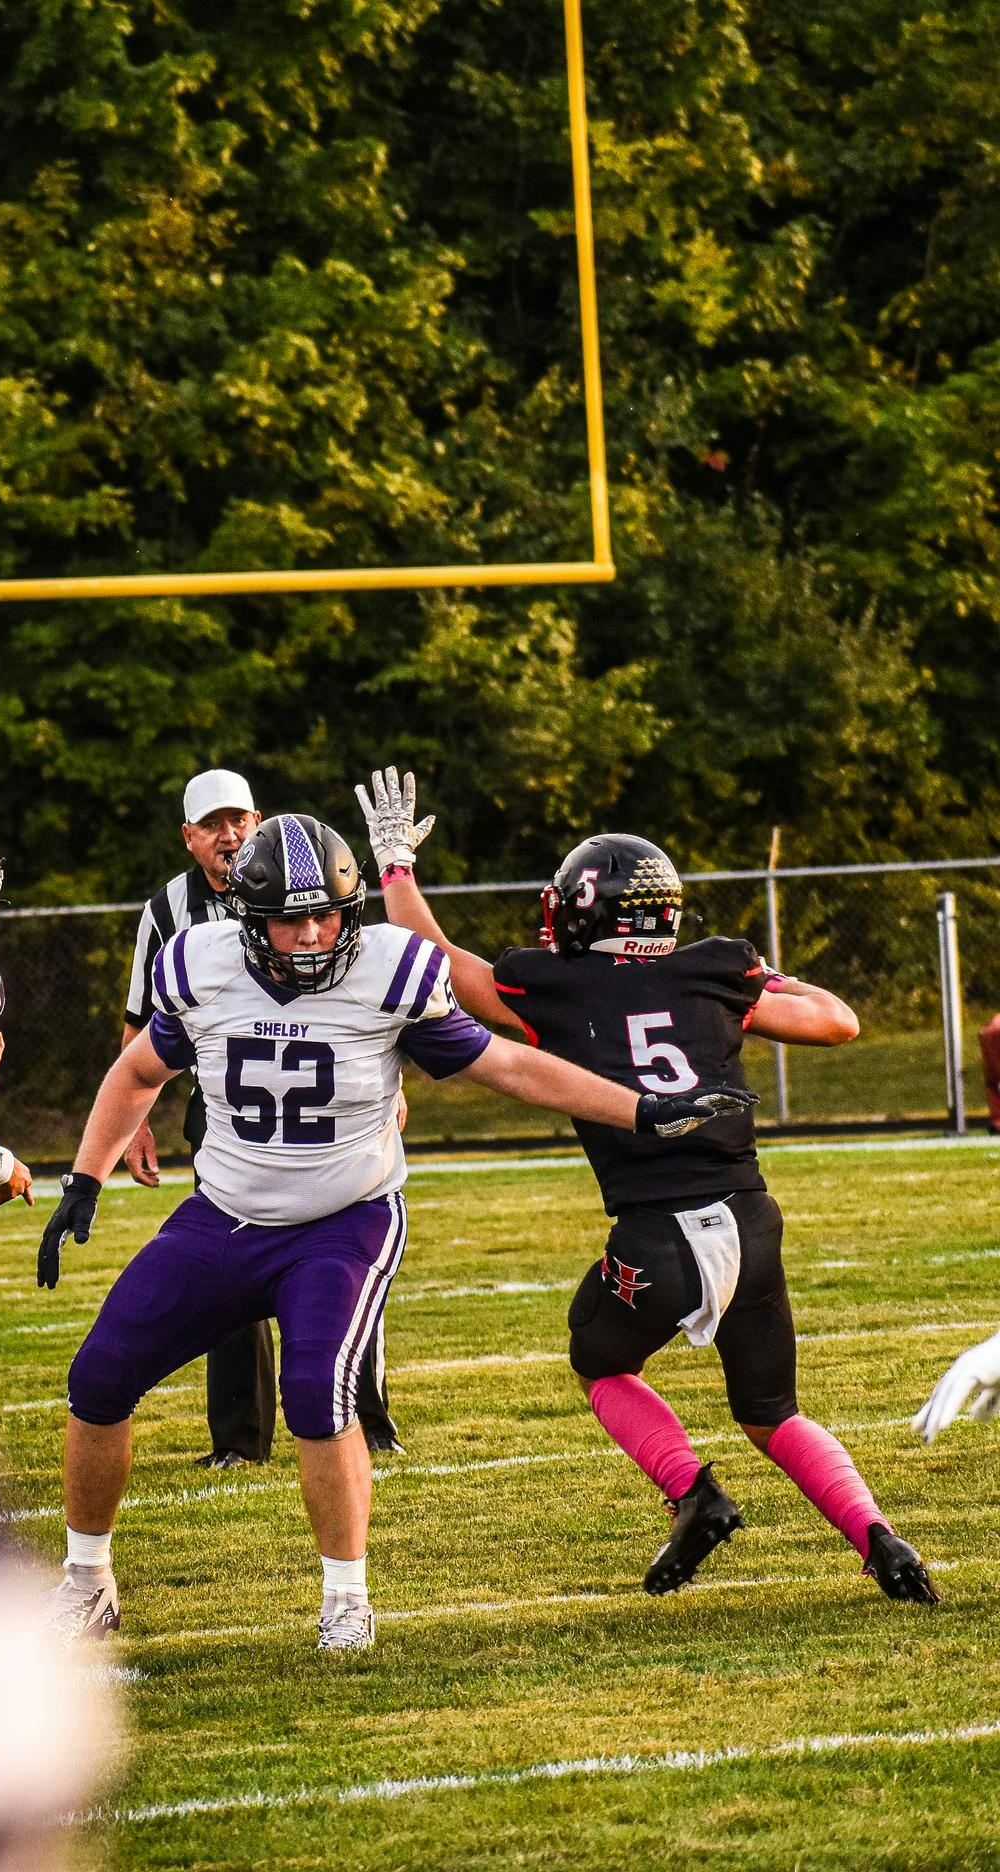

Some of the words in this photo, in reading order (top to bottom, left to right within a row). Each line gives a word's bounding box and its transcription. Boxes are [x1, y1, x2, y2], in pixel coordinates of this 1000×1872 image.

[292, 893, 308, 902] ALL
[575, 867, 600, 908] 5
[253, 1022, 310, 1038] SHELBY
[625, 1010, 700, 1095] 5
[225, 1036, 336, 1144] 52
